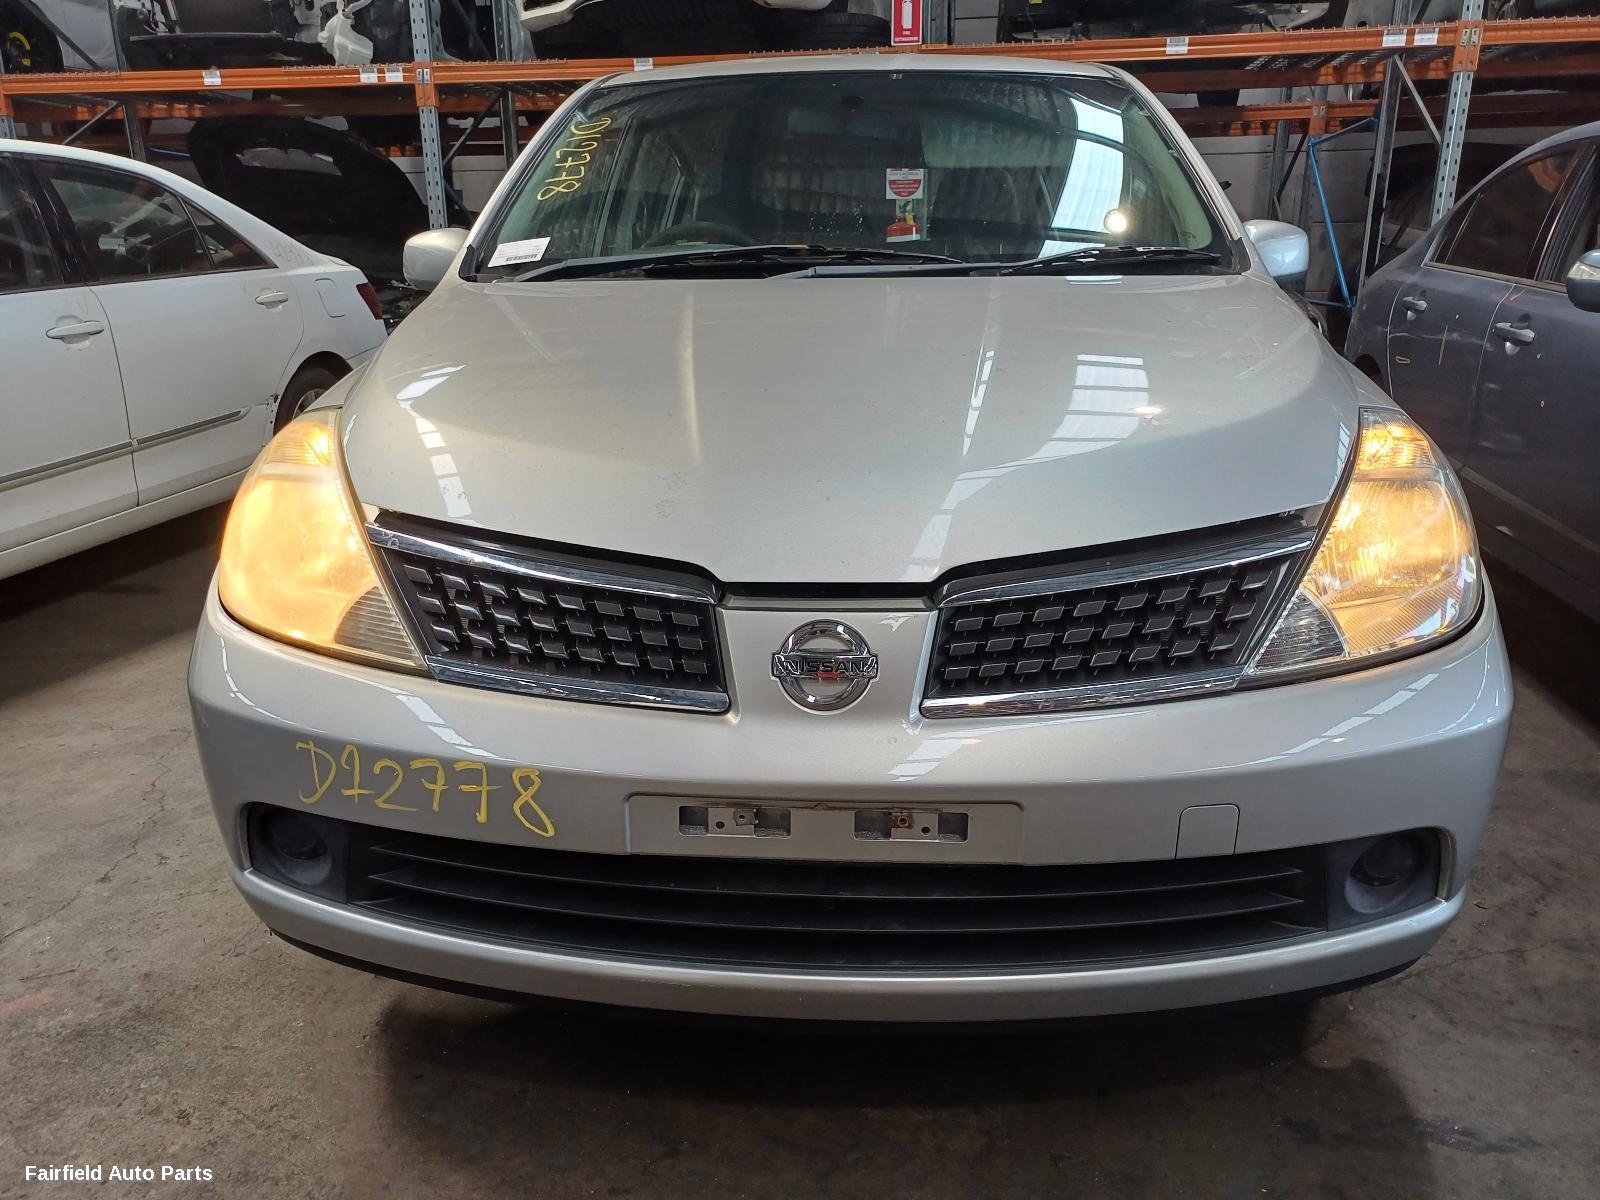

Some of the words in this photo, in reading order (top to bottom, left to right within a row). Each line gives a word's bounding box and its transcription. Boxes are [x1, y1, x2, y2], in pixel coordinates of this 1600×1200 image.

[536, 117, 612, 201] D12778
[784, 659, 865, 673] NISSAN
[296, 740, 555, 837] D12778
